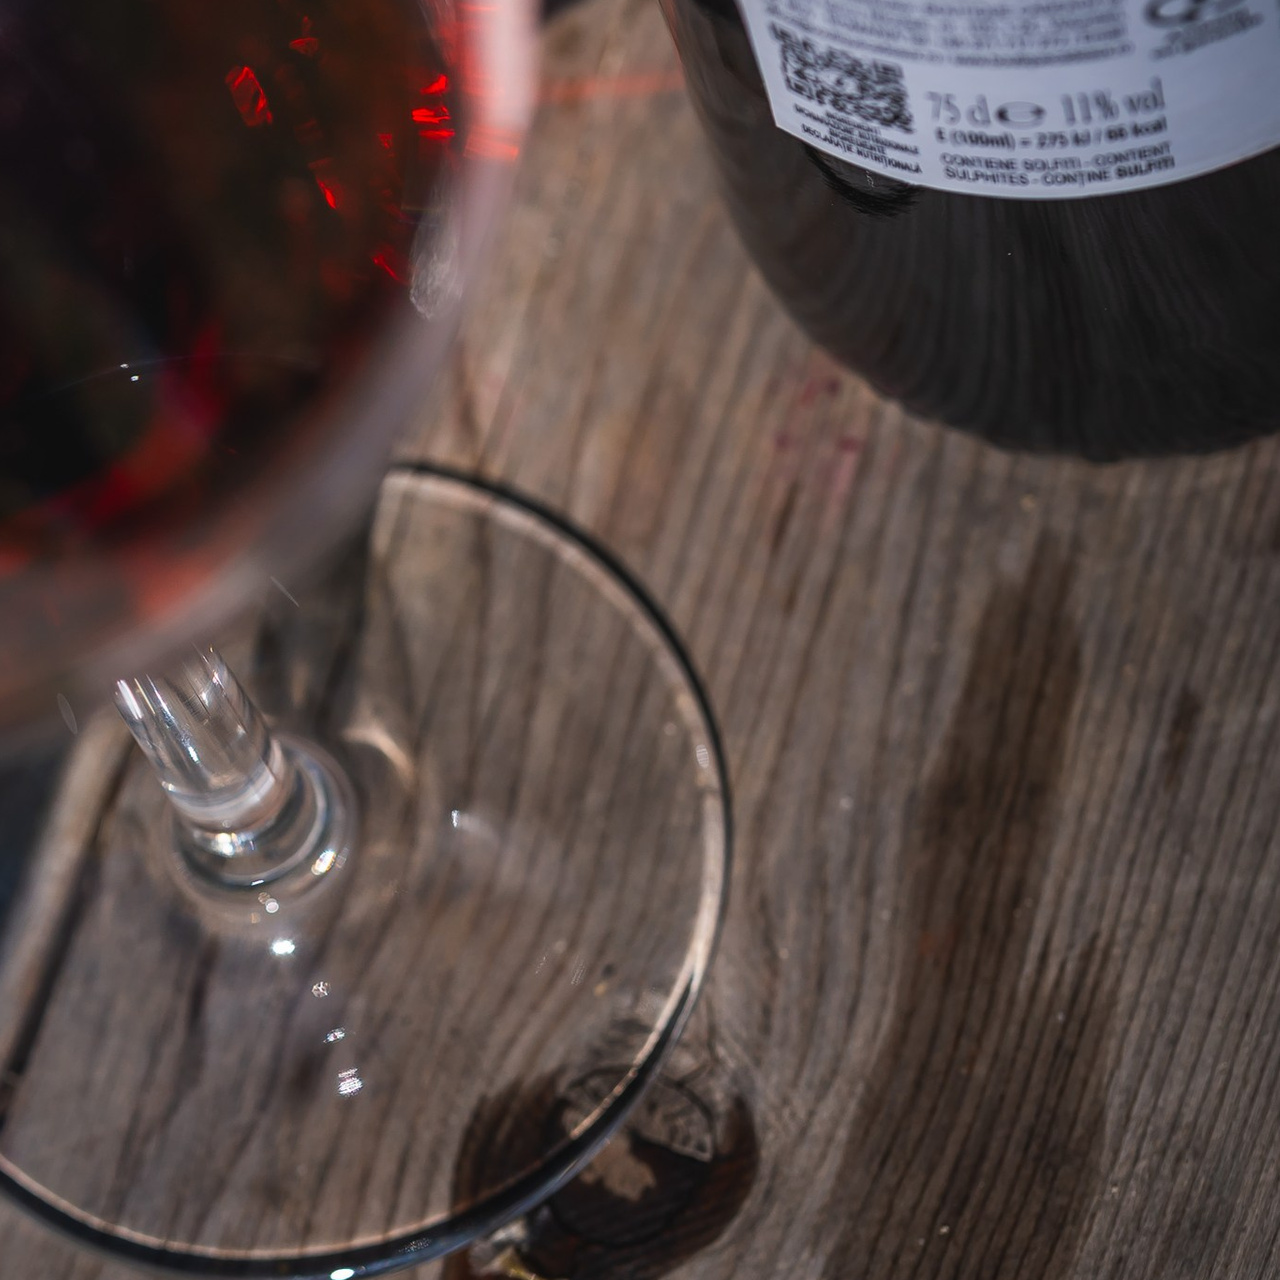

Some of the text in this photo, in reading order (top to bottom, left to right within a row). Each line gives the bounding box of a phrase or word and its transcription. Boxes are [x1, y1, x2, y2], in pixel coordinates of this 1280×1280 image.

[924, 91, 961, 126] 75
[1061, 91, 1120, 127] 11%
[1123, 75, 1166, 116] vol
[940, 153, 1017, 170] CONTIENE
[943, 165, 1029, 187] SULPHITES
